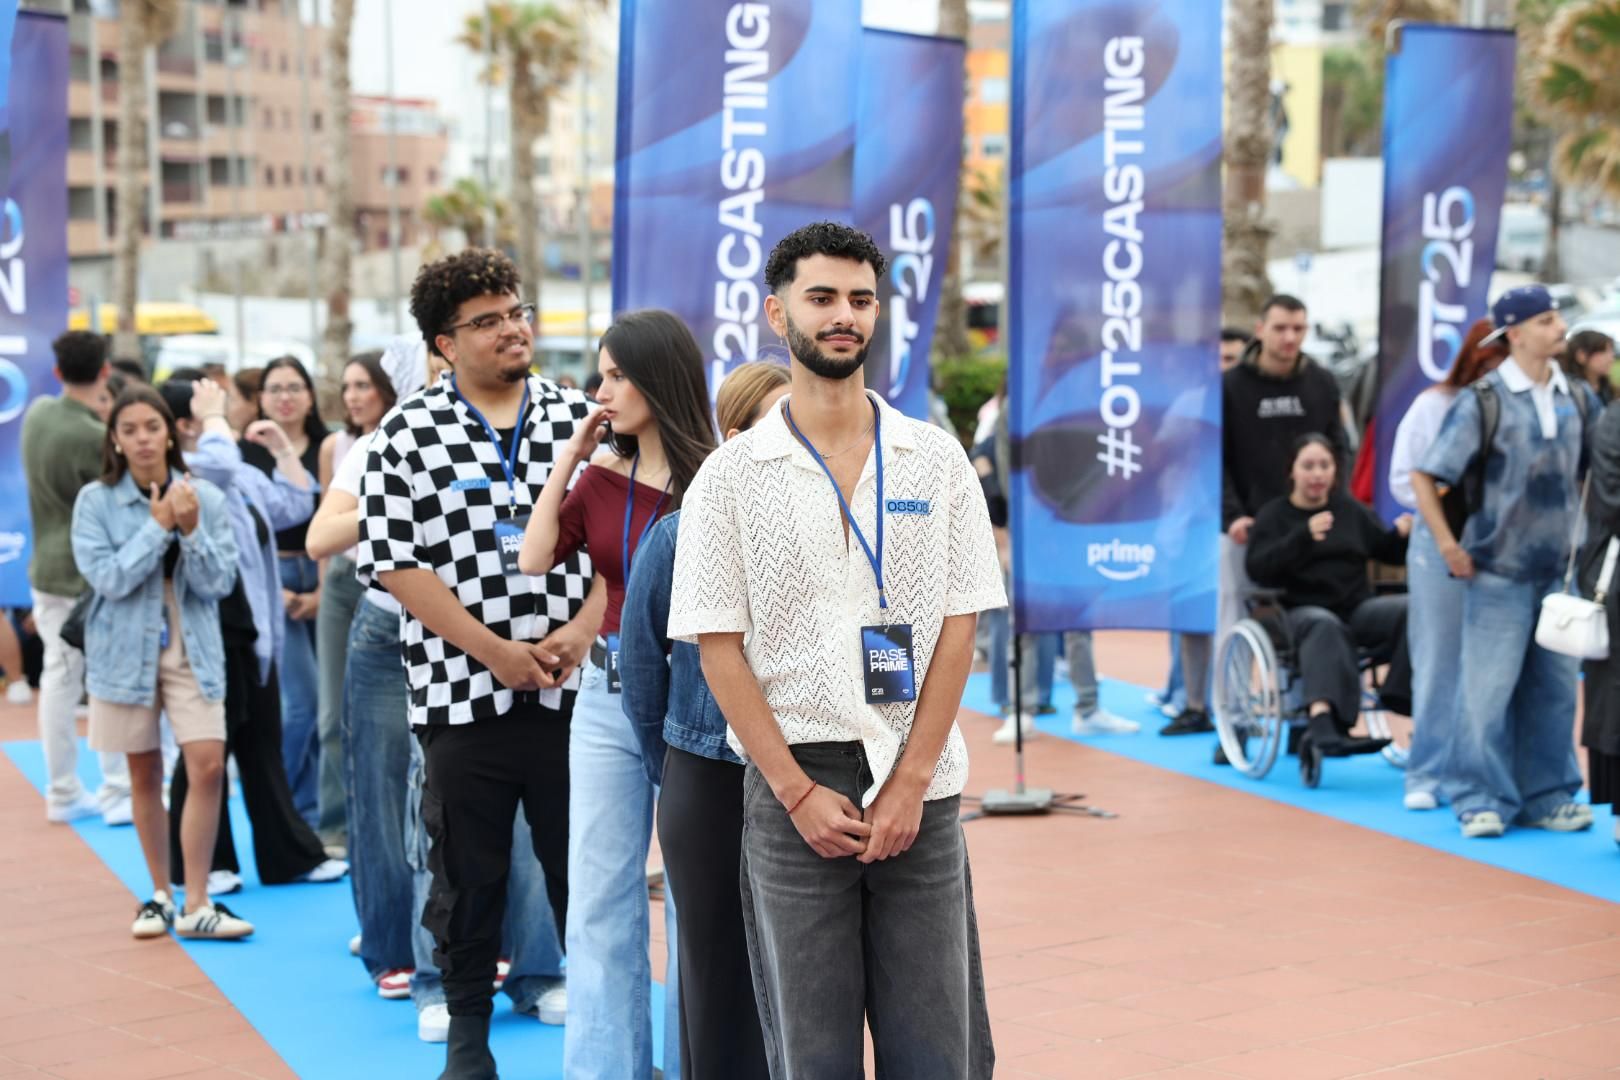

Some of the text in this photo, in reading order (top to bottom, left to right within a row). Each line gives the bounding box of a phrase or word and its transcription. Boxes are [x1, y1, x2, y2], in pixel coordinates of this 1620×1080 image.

[1096, 35, 1145, 481] #OT25CASTING
[1417, 185, 1477, 383] OT25
[500, 532, 525, 547] PAS
[1087, 538, 1156, 567] prime
[869, 648, 908, 662] PASE
[870, 660, 909, 673] PRIME
